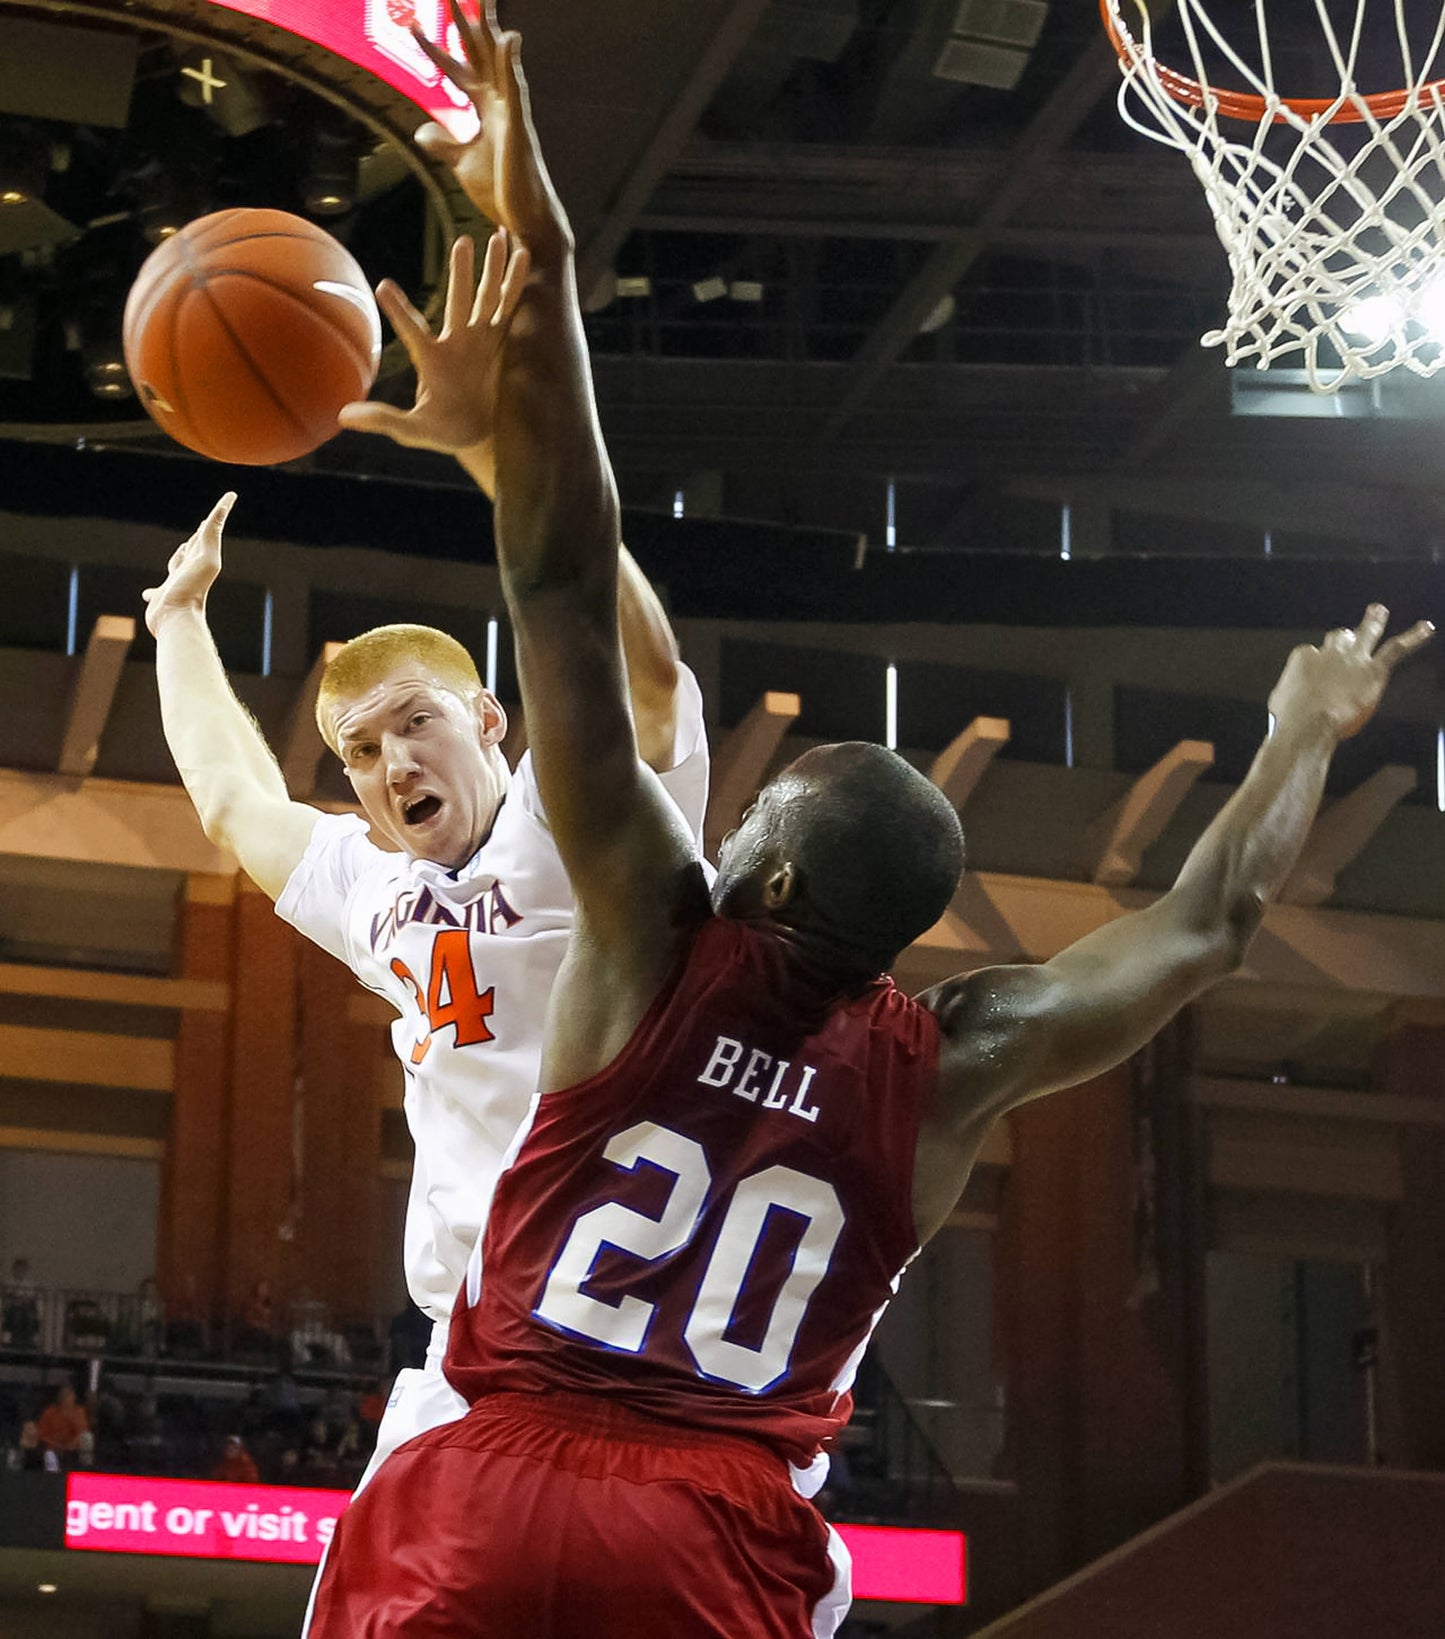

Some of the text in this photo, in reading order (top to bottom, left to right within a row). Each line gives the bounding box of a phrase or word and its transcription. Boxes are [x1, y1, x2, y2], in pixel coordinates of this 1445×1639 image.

[370, 879, 524, 954] VGINIA
[697, 1035, 820, 1122] BELL
[533, 1120, 845, 1394] 20
[66, 1500, 157, 1537] gent
[165, 1507, 214, 1535] or
[220, 1503, 308, 1542] visit
